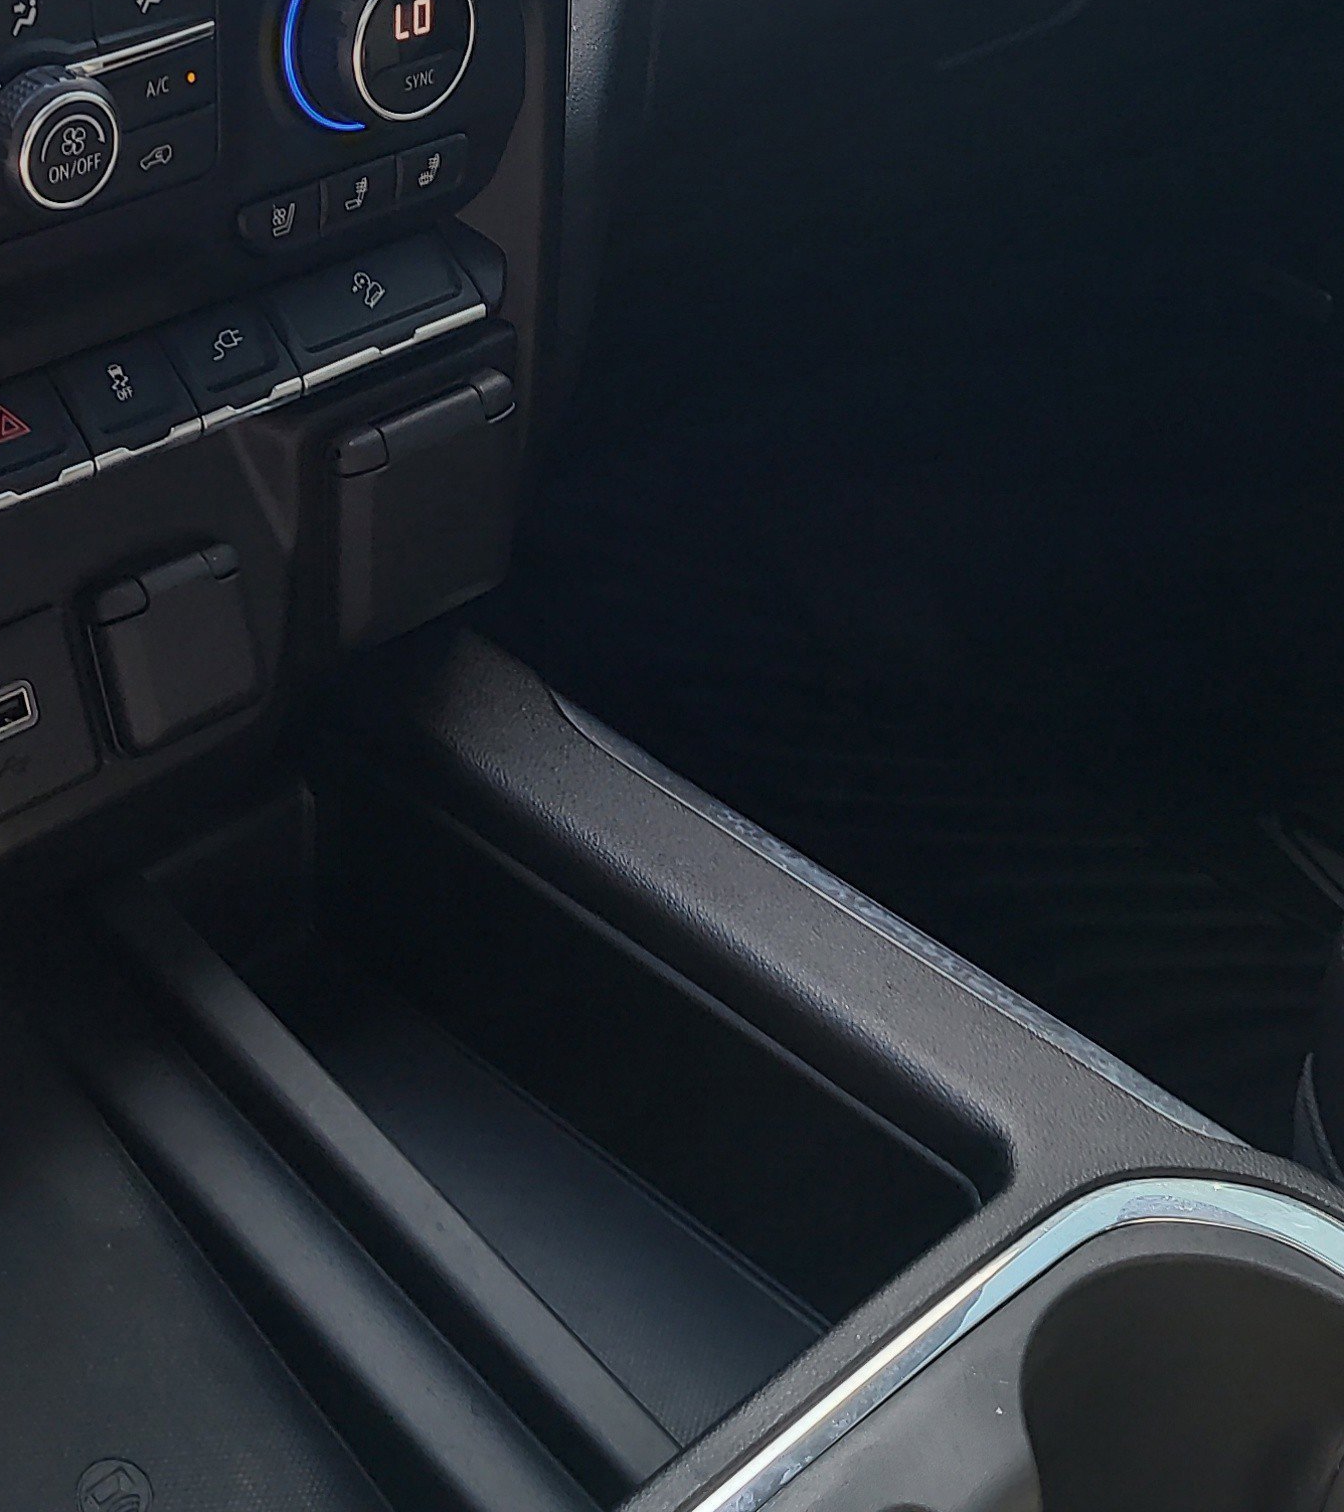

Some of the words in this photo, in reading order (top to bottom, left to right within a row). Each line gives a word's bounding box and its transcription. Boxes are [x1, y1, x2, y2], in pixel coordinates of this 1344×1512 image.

[146, 75, 170, 99] A/C
[404, 69, 435, 91] SYNC
[48, 152, 102, 184] ON/OFF
[117, 386, 134, 401] OFF
